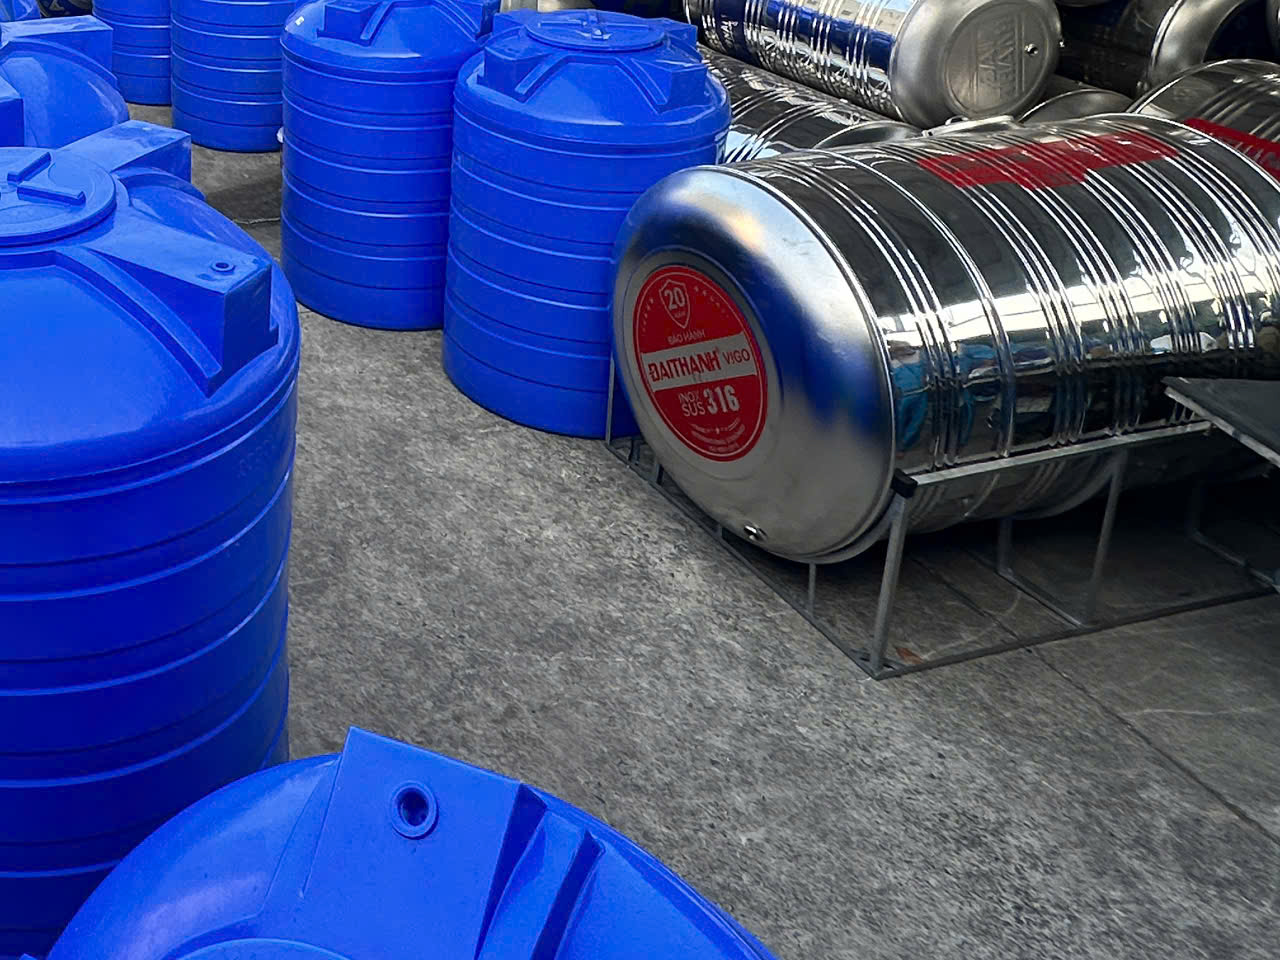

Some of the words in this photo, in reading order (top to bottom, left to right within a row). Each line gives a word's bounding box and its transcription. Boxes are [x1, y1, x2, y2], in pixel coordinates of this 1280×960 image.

[664, 288, 686, 311] 20
[722, 348, 751, 365] VIGO
[678, 390, 700, 405] INOX
[681, 401, 706, 417] SUS
[703, 384, 740, 415] 316
